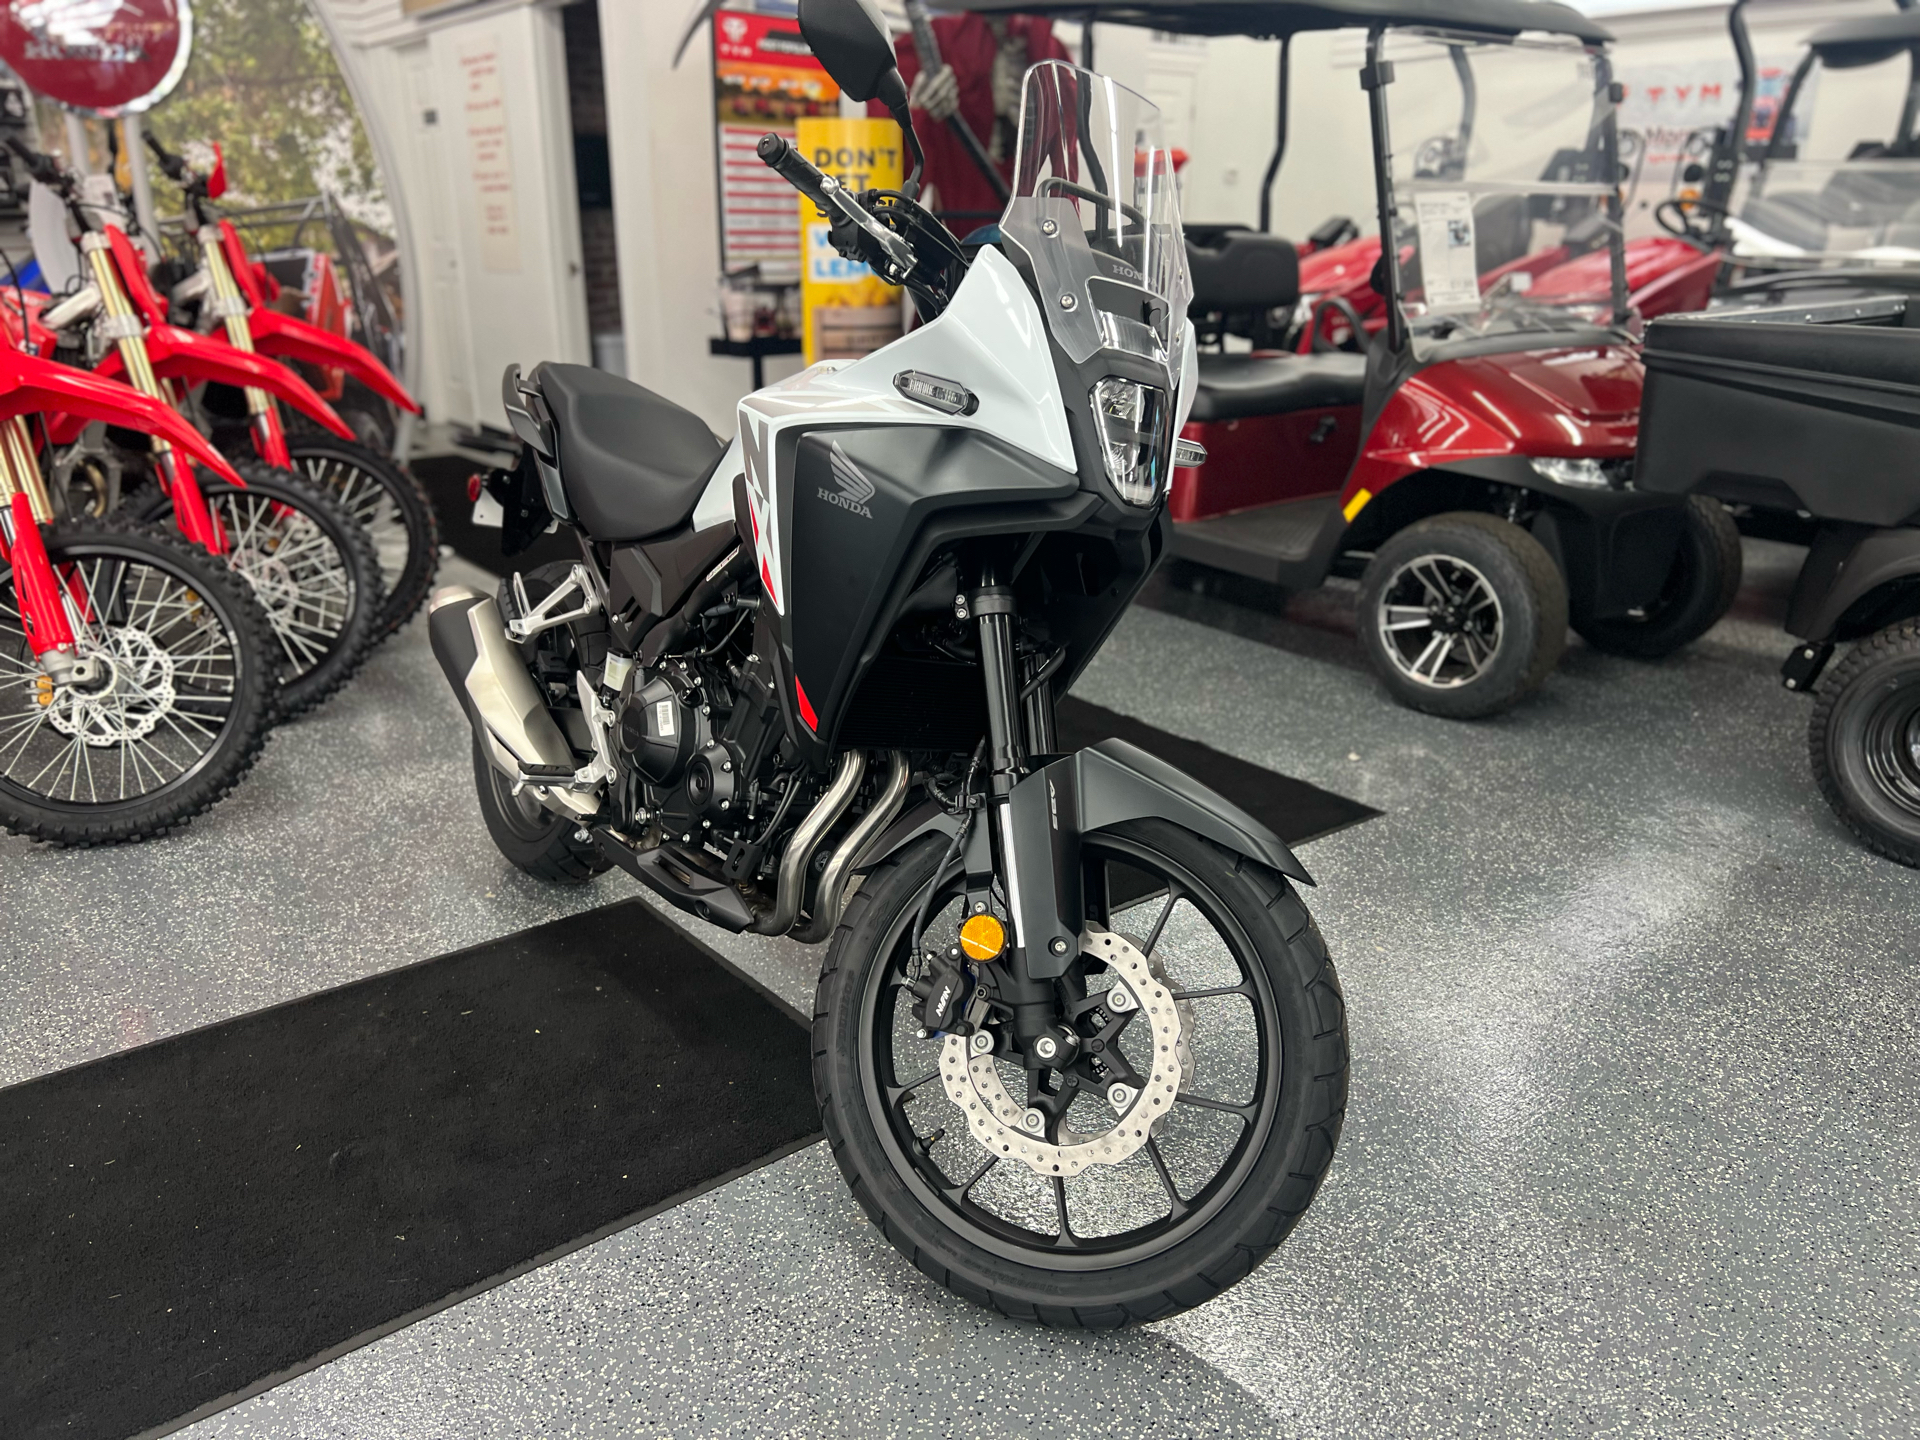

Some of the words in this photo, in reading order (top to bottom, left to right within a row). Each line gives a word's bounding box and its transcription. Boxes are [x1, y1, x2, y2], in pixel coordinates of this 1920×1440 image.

[1647, 83, 1722, 103] TYM
[815, 148, 898, 169] DON'T
[815, 258, 879, 277] LEM
[817, 487, 873, 520] HONDA
